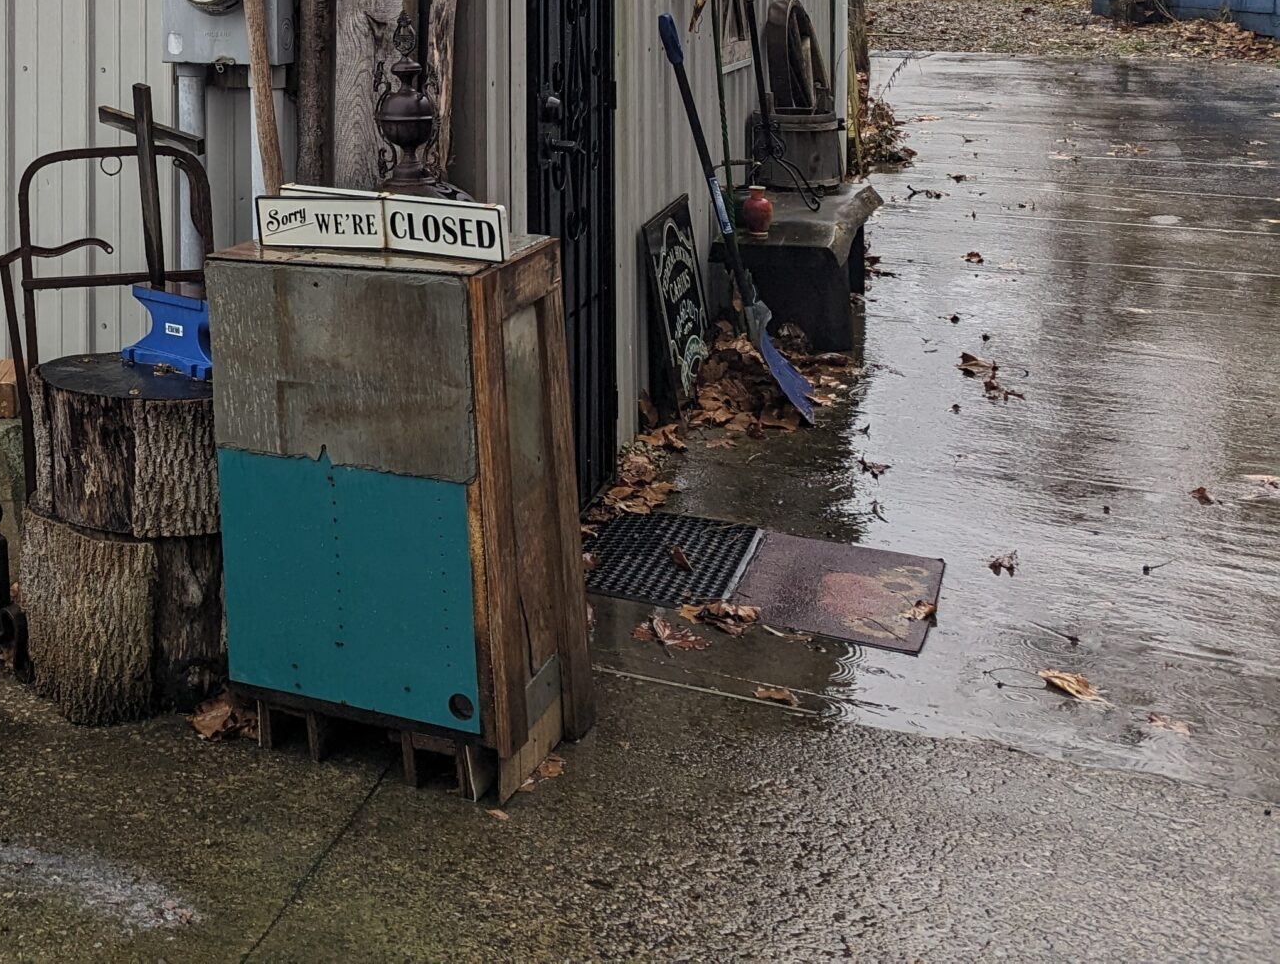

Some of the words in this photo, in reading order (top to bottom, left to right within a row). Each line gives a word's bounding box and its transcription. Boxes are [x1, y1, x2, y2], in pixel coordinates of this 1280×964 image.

[266, 206, 306, 232] Sorry
[314, 212, 377, 235] WE'RE
[390, 211, 496, 249] CLOSED
